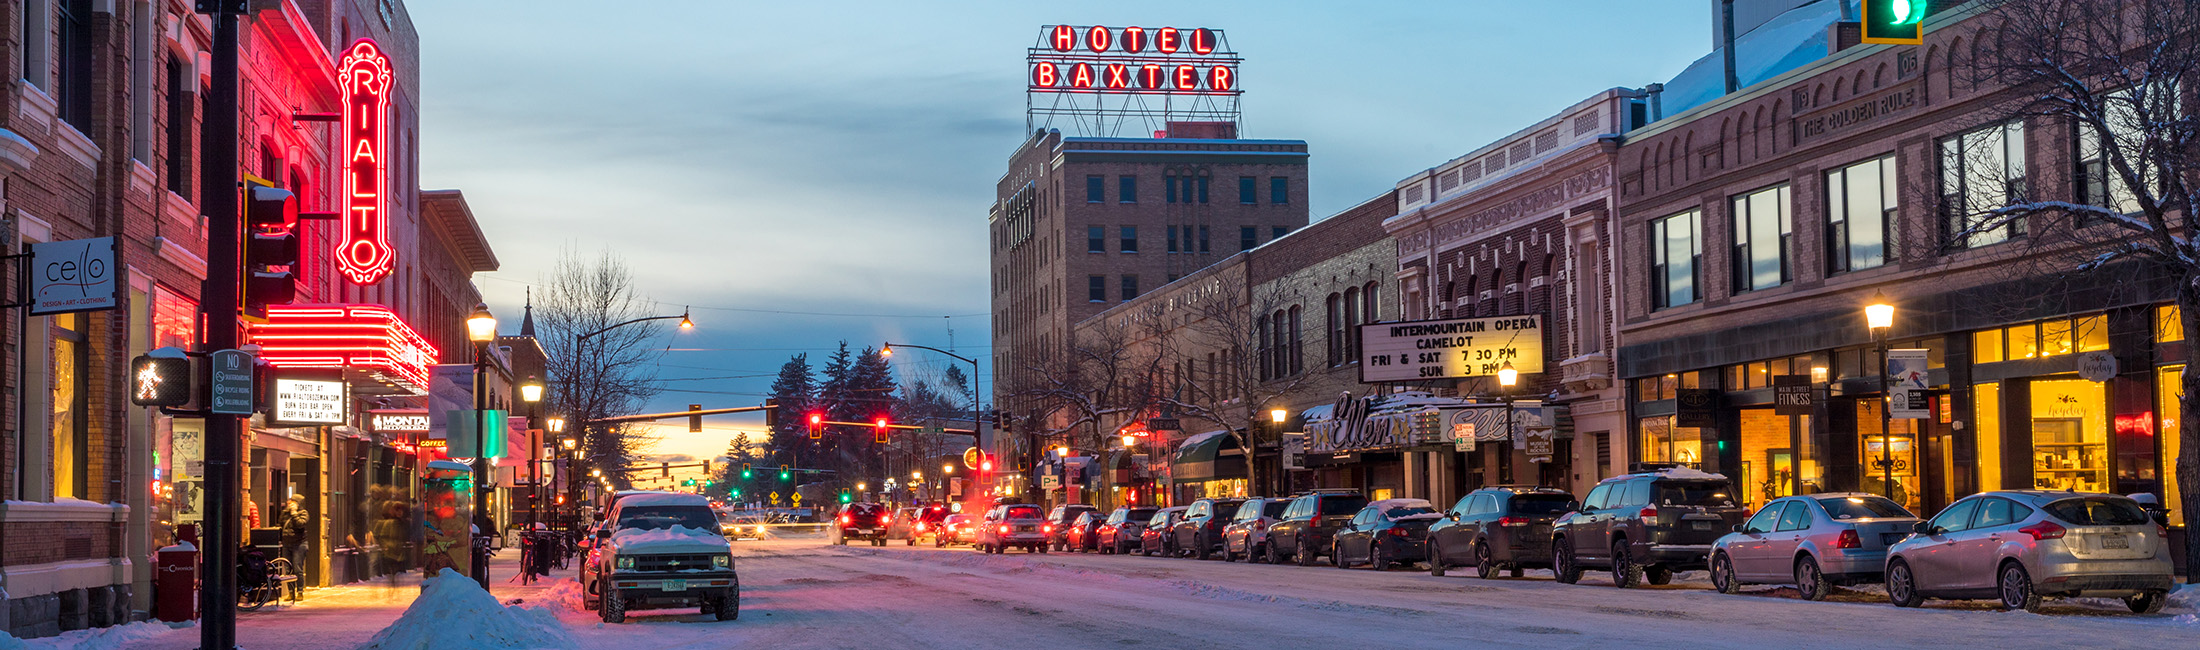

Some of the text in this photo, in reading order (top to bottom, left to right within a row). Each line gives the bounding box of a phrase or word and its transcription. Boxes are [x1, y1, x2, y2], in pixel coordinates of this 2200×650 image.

[1055, 25, 1213, 53] HOTEL
[1902, 54, 1917, 74] 06
[1037, 62, 1230, 90] BAXTER
[1798, 91, 1808, 107] 19
[1803, 87, 1915, 138] THE GOLDEN RULE
[351, 68, 377, 267] RIALTO
[46, 243, 105, 297] cello
[42, 300, 62, 308] DESIGN
[79, 296, 107, 305] CLOTHING
[1390, 318, 1537, 338] INTERMOUNTAIN OPERA
[1416, 336, 1474, 350] CAMELOT
[226, 353, 240, 369] NO
[1371, 347, 1517, 366] FRI & SAT 7 30 PM
[1419, 362, 1499, 378] SUN 3 PM
[2083, 362, 2112, 375] heyday
[294, 383, 313, 392] TICKETS
[1793, 385, 1810, 393] STREET
[285, 401, 296, 409] BURN
[322, 403, 333, 411] OPEN
[1778, 392, 1811, 406] FITNESS
[2048, 403, 2087, 418] heyday
[1152, 419, 1179, 429] NEWS
[1331, 391, 1393, 449] Ellen
[1043, 477, 1051, 487] P
